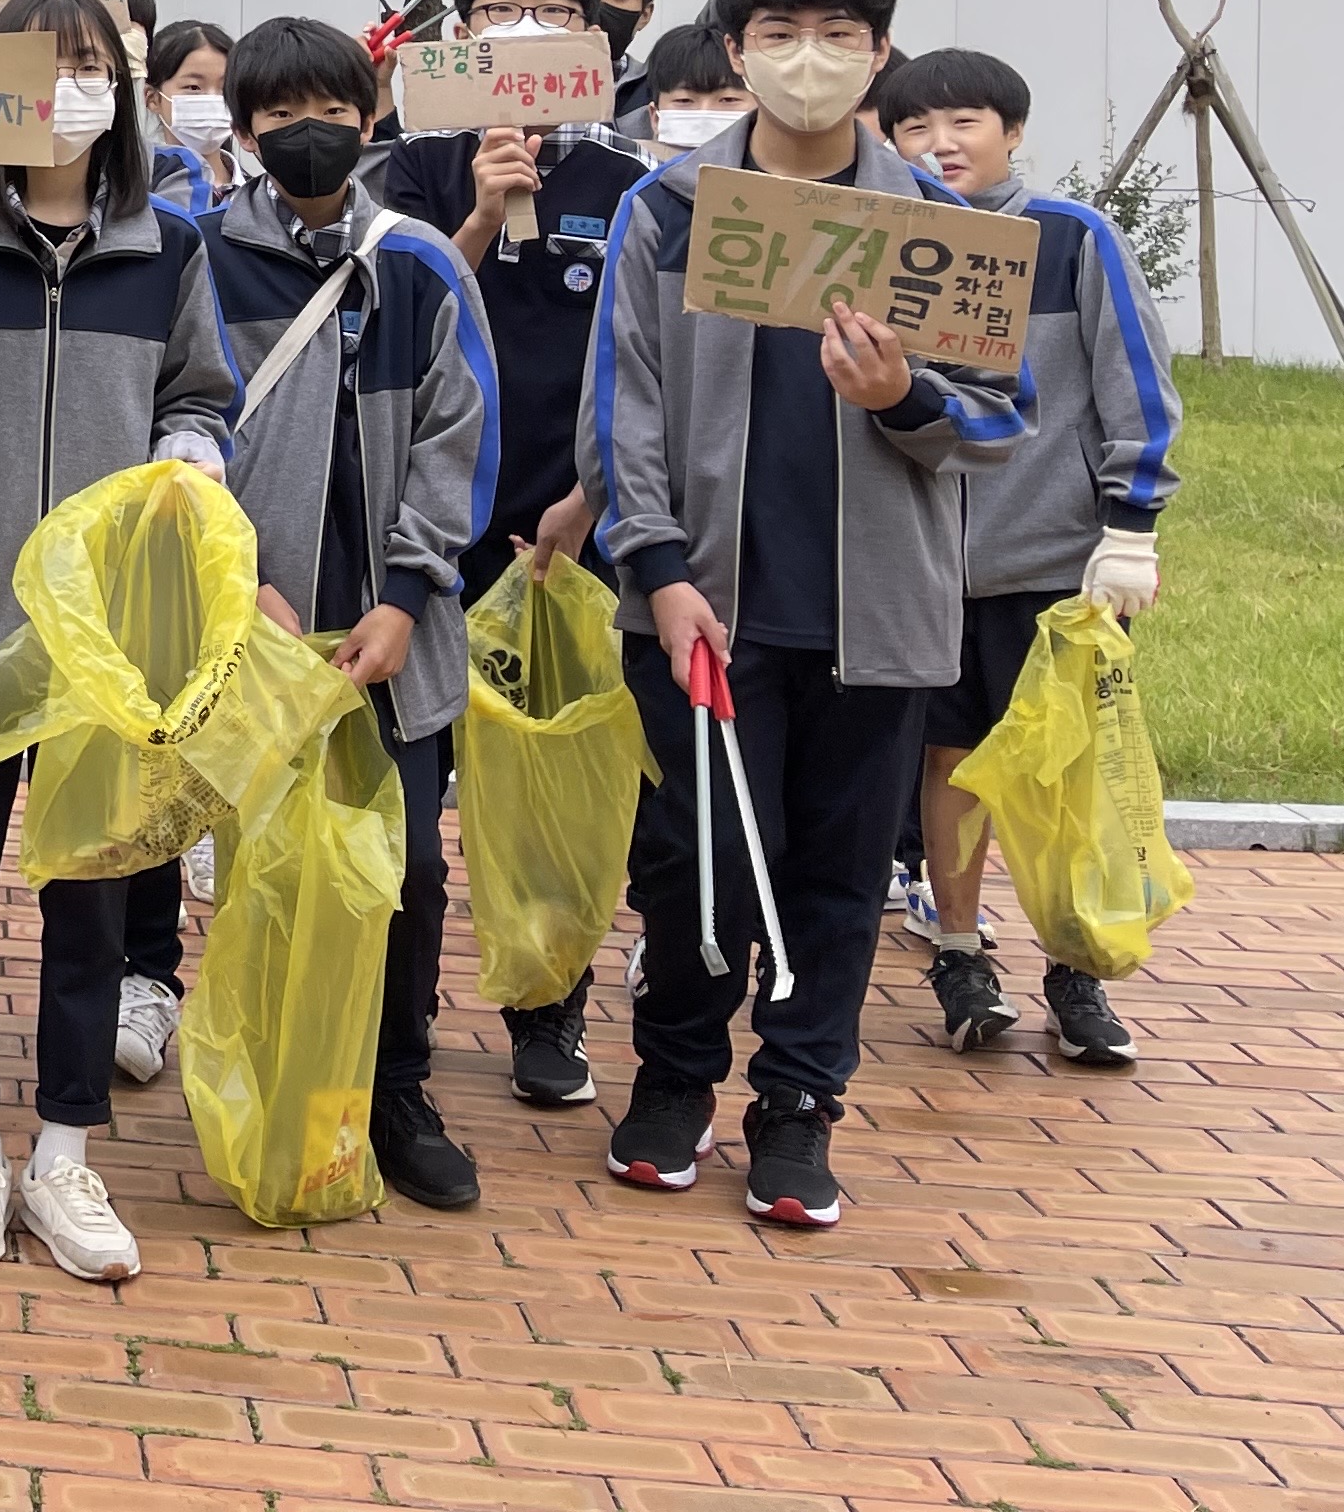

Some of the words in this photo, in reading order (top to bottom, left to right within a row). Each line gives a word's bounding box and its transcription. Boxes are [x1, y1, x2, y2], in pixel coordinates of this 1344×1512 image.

[420, 42, 494, 79] 환경을
[703, 196, 954, 331] 환경을
[966, 253, 1028, 278] 자기
[955, 276, 1003, 298] 자신
[953, 298, 1012, 338] 처럼
[936, 331, 1017, 360] 지키자
